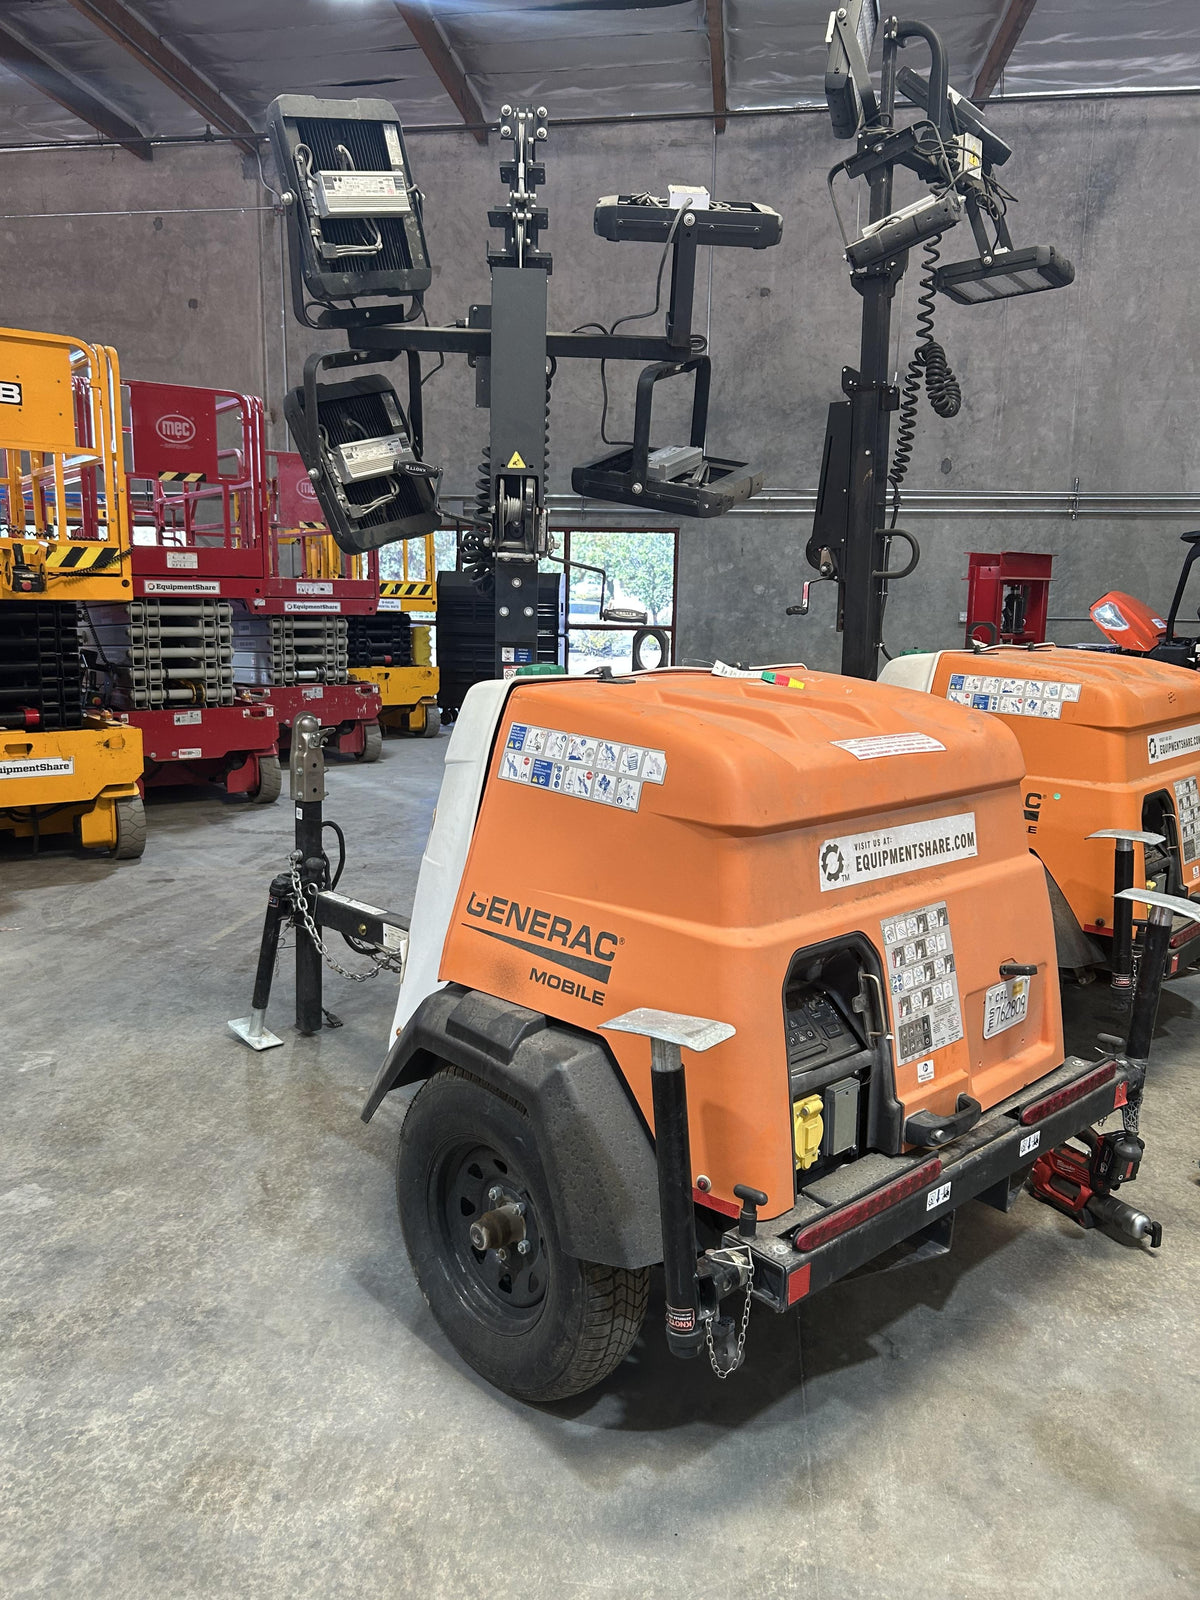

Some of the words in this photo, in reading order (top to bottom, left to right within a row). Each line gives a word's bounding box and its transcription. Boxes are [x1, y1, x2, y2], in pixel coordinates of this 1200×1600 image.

[156, 582, 217, 592] EquipmentShare
[293, 603, 339, 611] EquipmentShare
[854, 838, 871, 851] VISIT
[873, 837, 881, 847] US
[882, 835, 893, 846] AT:
[855, 832, 975, 872] EQUIPMENTSHARE.COM
[529, 967, 606, 1006] MOBILE
